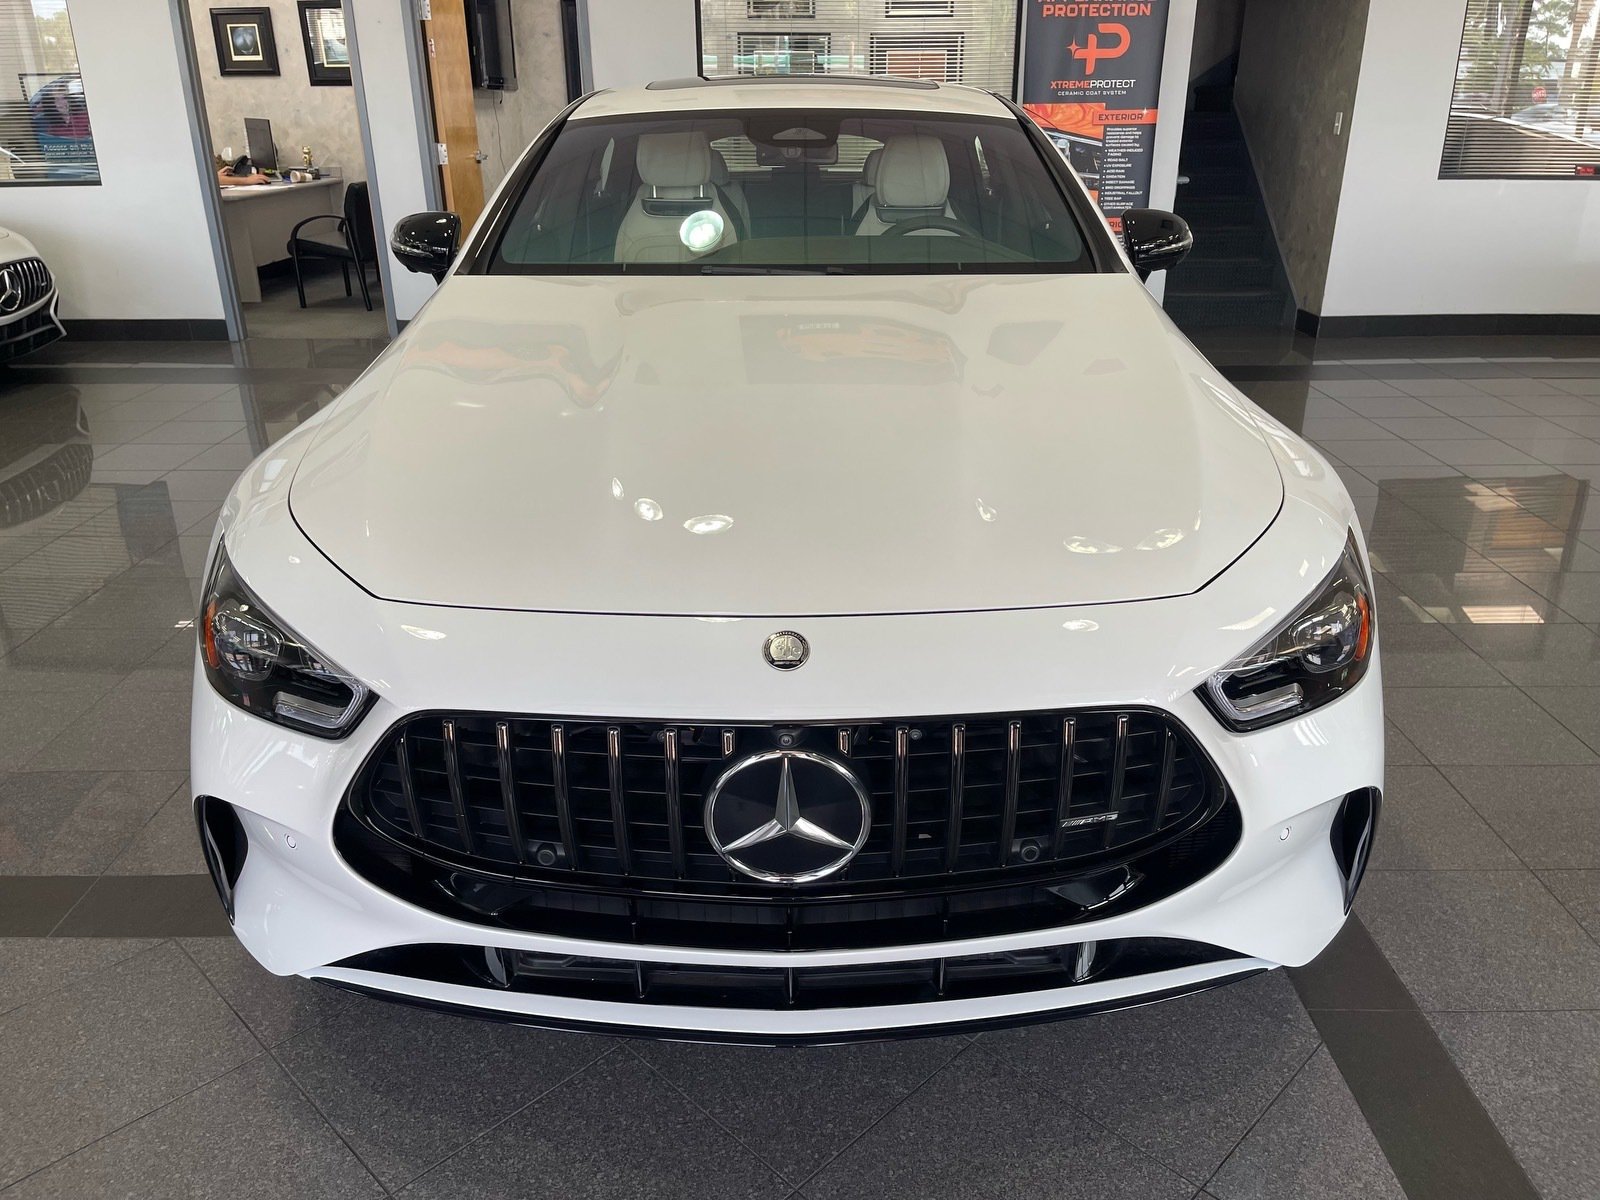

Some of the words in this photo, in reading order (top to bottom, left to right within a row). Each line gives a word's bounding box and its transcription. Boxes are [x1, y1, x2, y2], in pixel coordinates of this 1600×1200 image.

[1042, 3, 1151, 17] PROTECTION
[1050, 80, 1136, 89] XTREMEPROTECT
[1098, 113, 1144, 121] EXTERIOR
